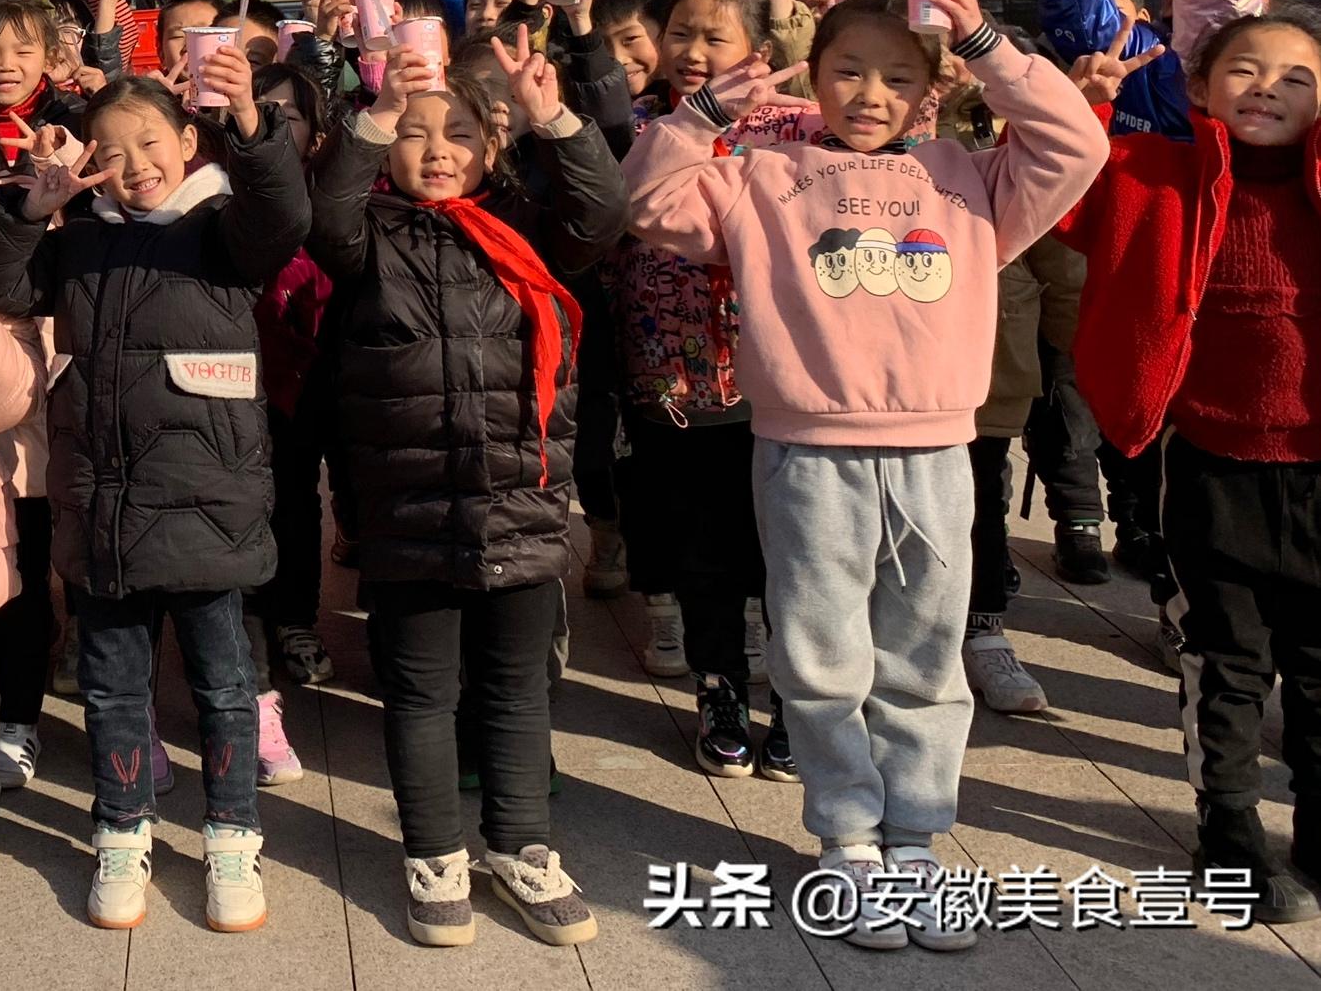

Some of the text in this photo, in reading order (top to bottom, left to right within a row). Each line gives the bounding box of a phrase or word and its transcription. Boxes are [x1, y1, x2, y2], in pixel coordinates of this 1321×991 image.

[778, 176, 814, 206] MAKES
[817, 161, 857, 178] YOUR
[861, 159, 895, 171] LIFE
[837, 198, 921, 217] SEE YOU!
